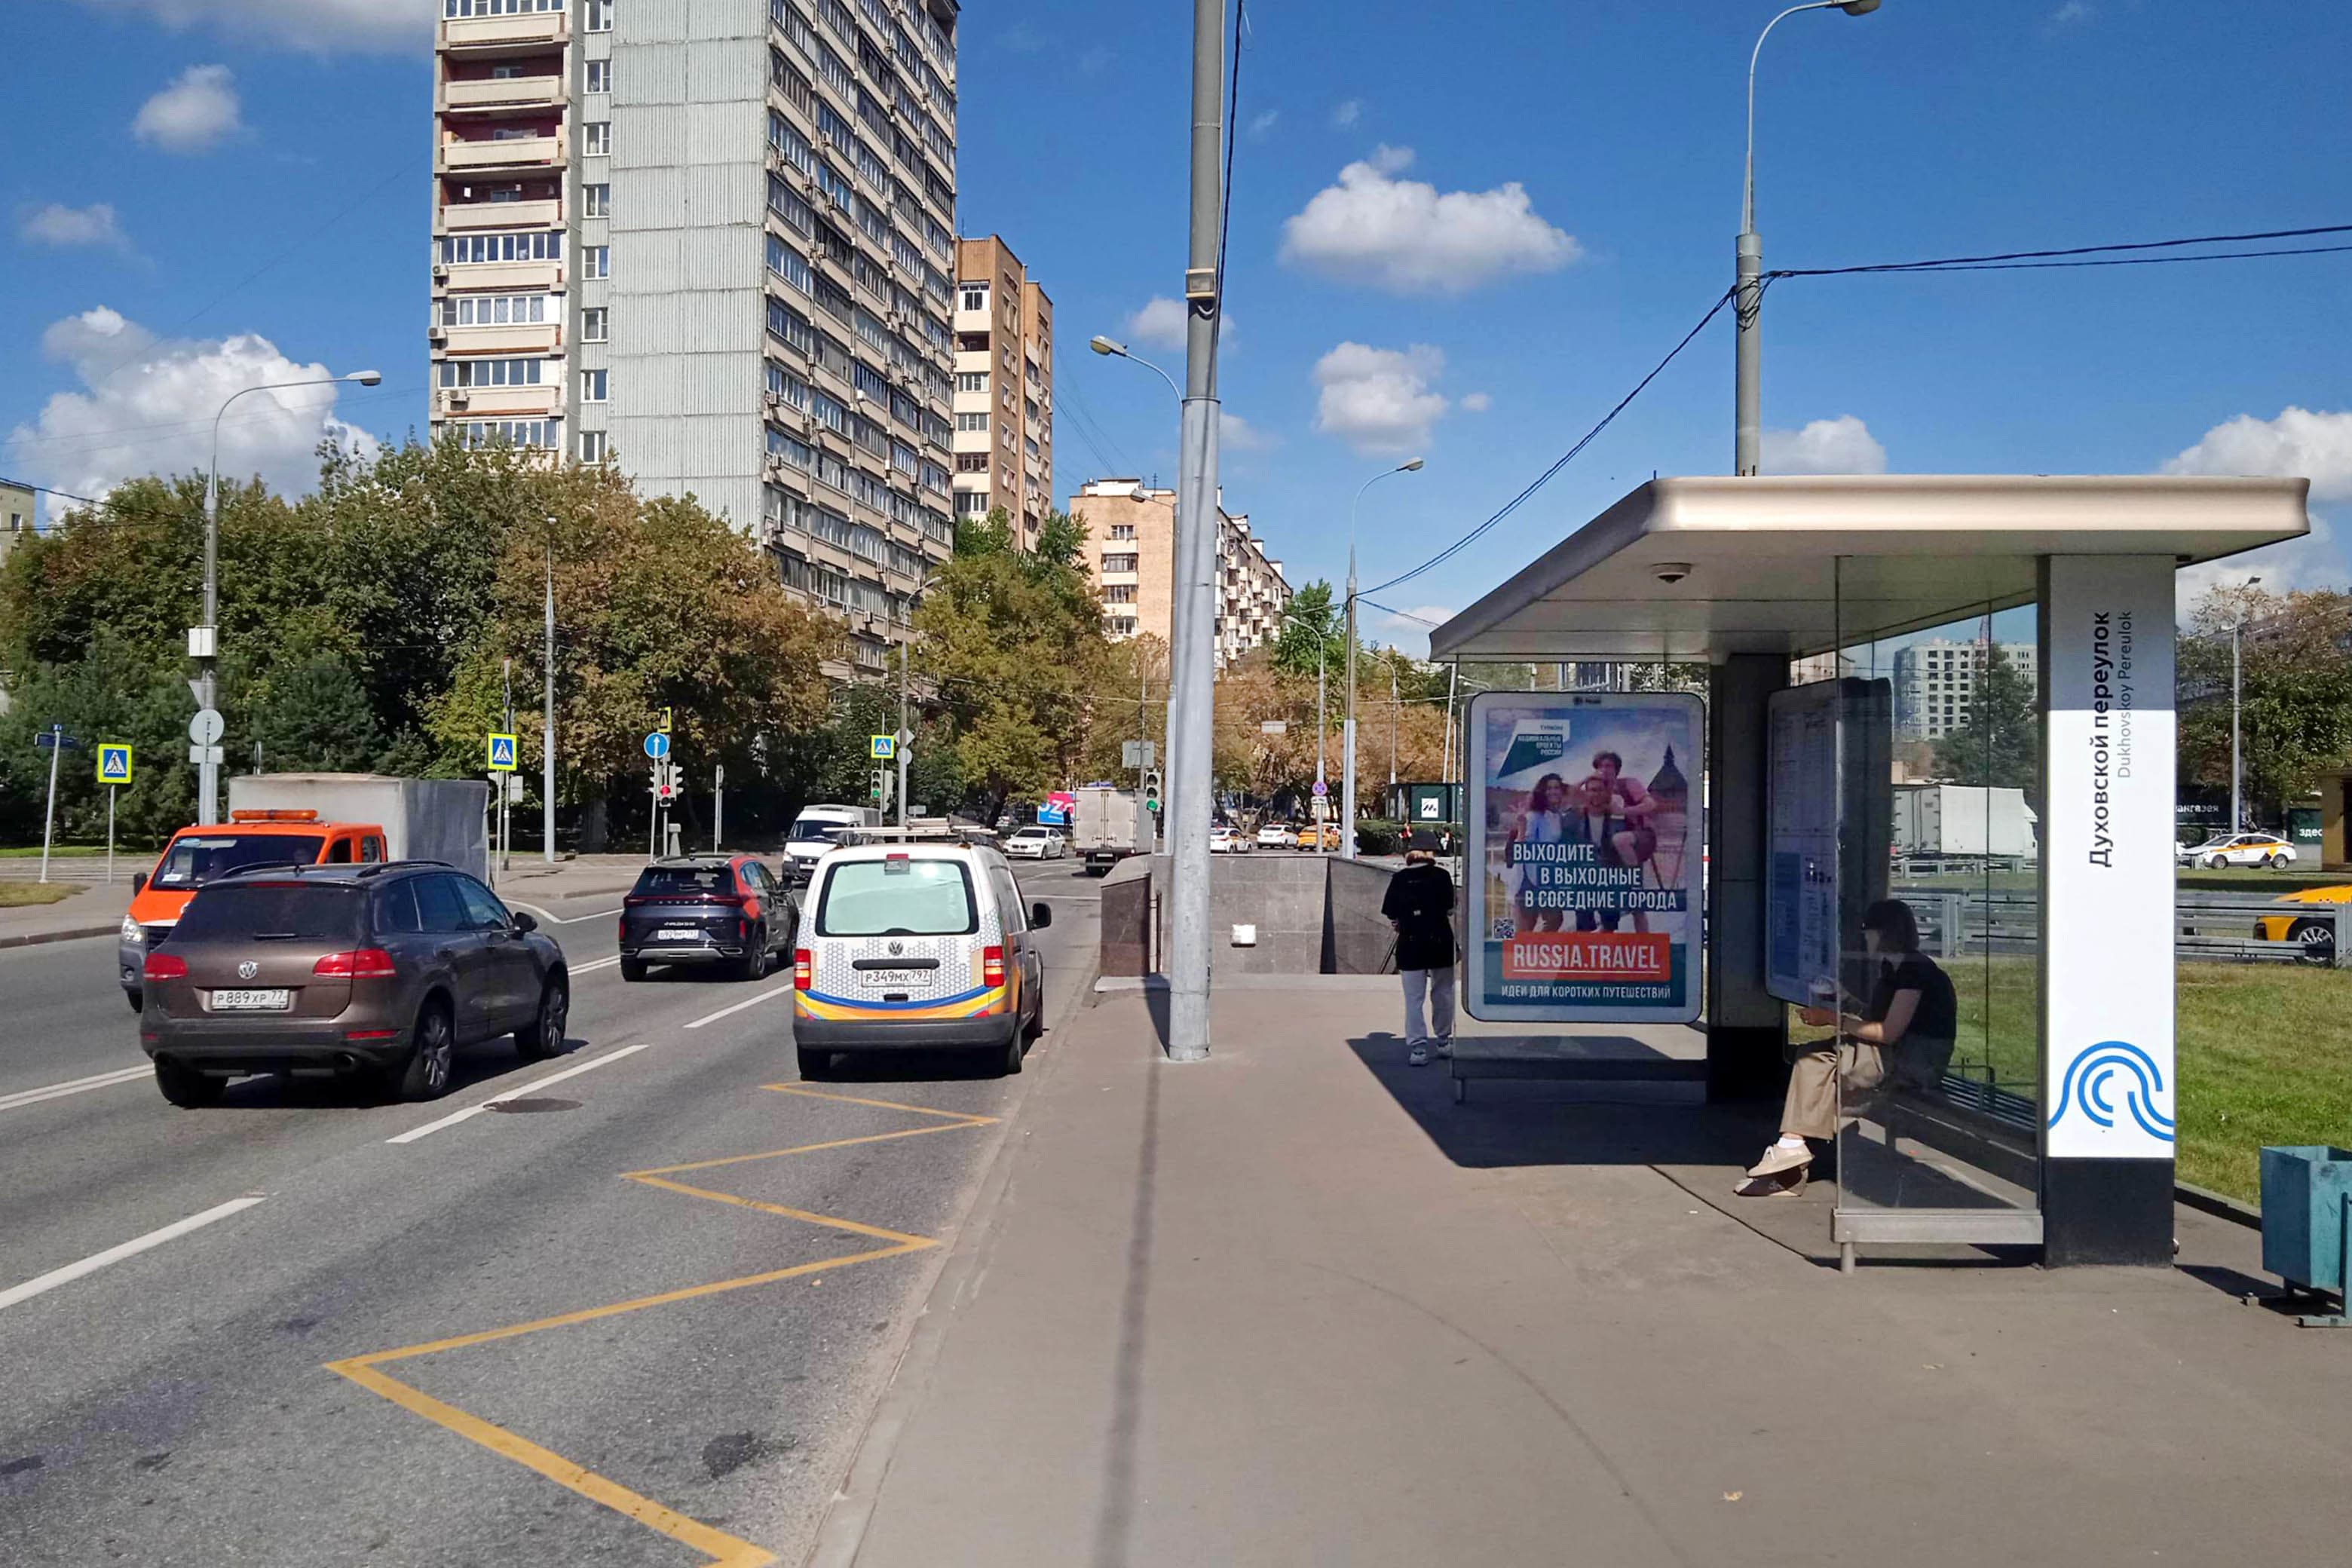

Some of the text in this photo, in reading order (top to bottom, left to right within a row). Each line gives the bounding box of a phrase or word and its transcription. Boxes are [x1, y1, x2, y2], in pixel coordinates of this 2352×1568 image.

[2117, 611, 2134, 779] Dukhovskoy Pereulok
[2090, 611, 2113, 868] Духовской переулок
[2299, 828, 2322, 838] здес
[1513, 844, 1594, 862] ВЫХОДИТЕ
[1541, 868, 1641, 887] В ВЫХОДНЫЕ
[1525, 890, 1677, 910] В СОСЕДНИЕ ГОРОДА
[1513, 944, 1660, 969] RUSSIA.TRAVEL
[1501, 985, 1671, 999] ИДЕИ ДЛЯ КОРОТКИХ ПУТЕШЕСТВИЙ
